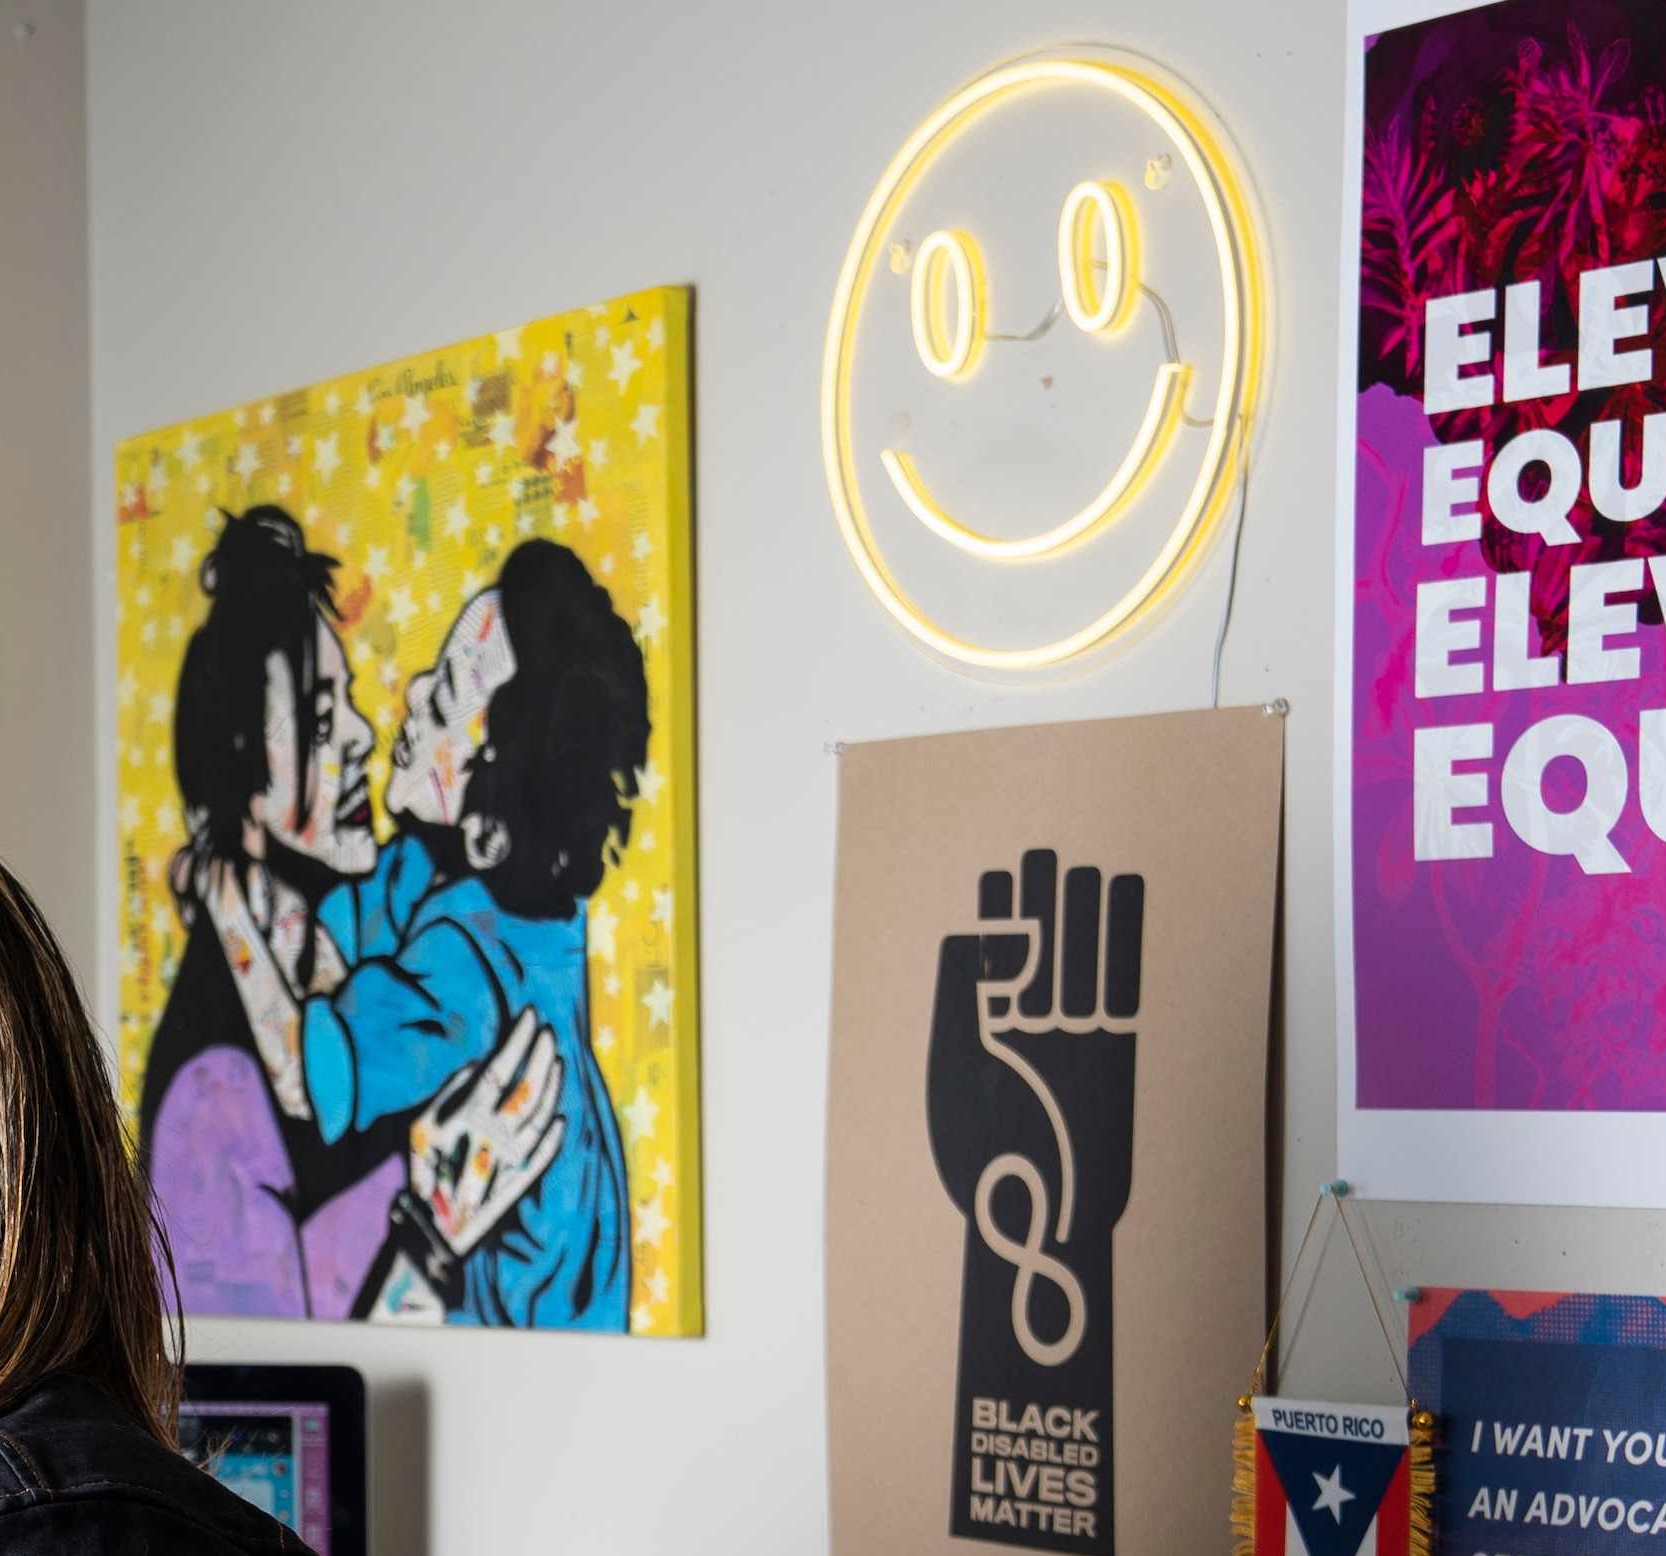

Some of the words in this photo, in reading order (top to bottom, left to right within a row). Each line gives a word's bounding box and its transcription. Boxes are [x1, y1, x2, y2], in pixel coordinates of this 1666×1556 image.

[972, 1397, 1100, 1443] BLACK
[1272, 1409, 1338, 1434] PUERTO
[1343, 1417, 1385, 1439] RICO
[971, 1432, 1099, 1469] DISABLED
[1471, 1421, 1483, 1453] I
[1493, 1422, 1593, 1461] WANT
[971, 1456, 1098, 1508] LIVES
[970, 1495, 1096, 1539] MATTER
[1468, 1486, 1518, 1522] AN
